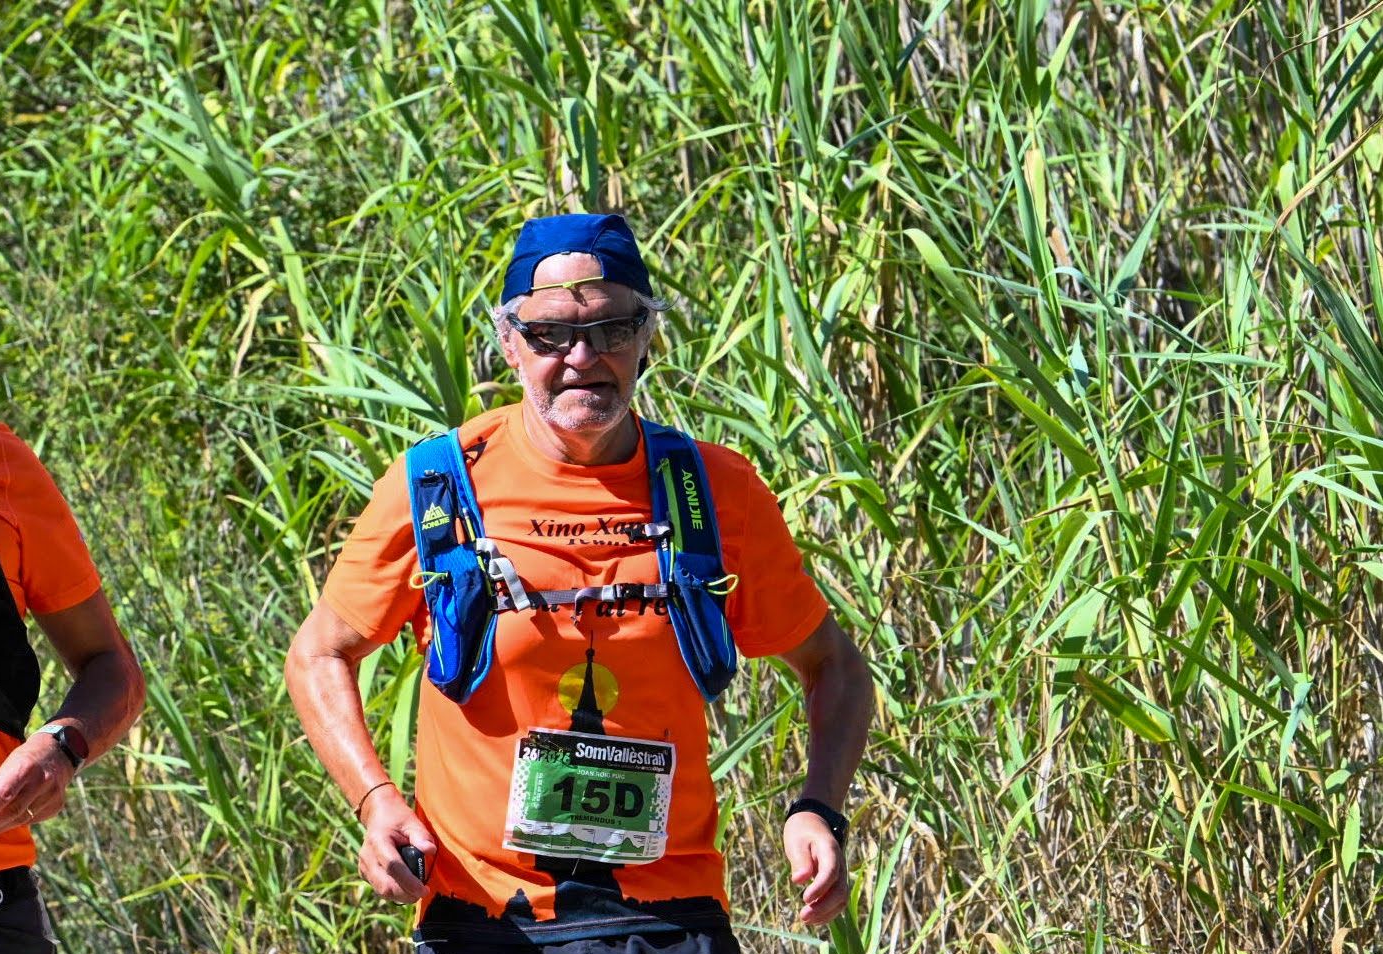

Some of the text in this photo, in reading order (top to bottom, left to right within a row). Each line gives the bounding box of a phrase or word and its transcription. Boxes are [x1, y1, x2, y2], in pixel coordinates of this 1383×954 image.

[681, 467, 704, 530] AONIJIE
[528, 519, 586, 537] Xino
[575, 742, 667, 766] SomVallèstrail
[553, 775, 644, 818] 15D
[570, 815, 616, 825] TREMENDUS
